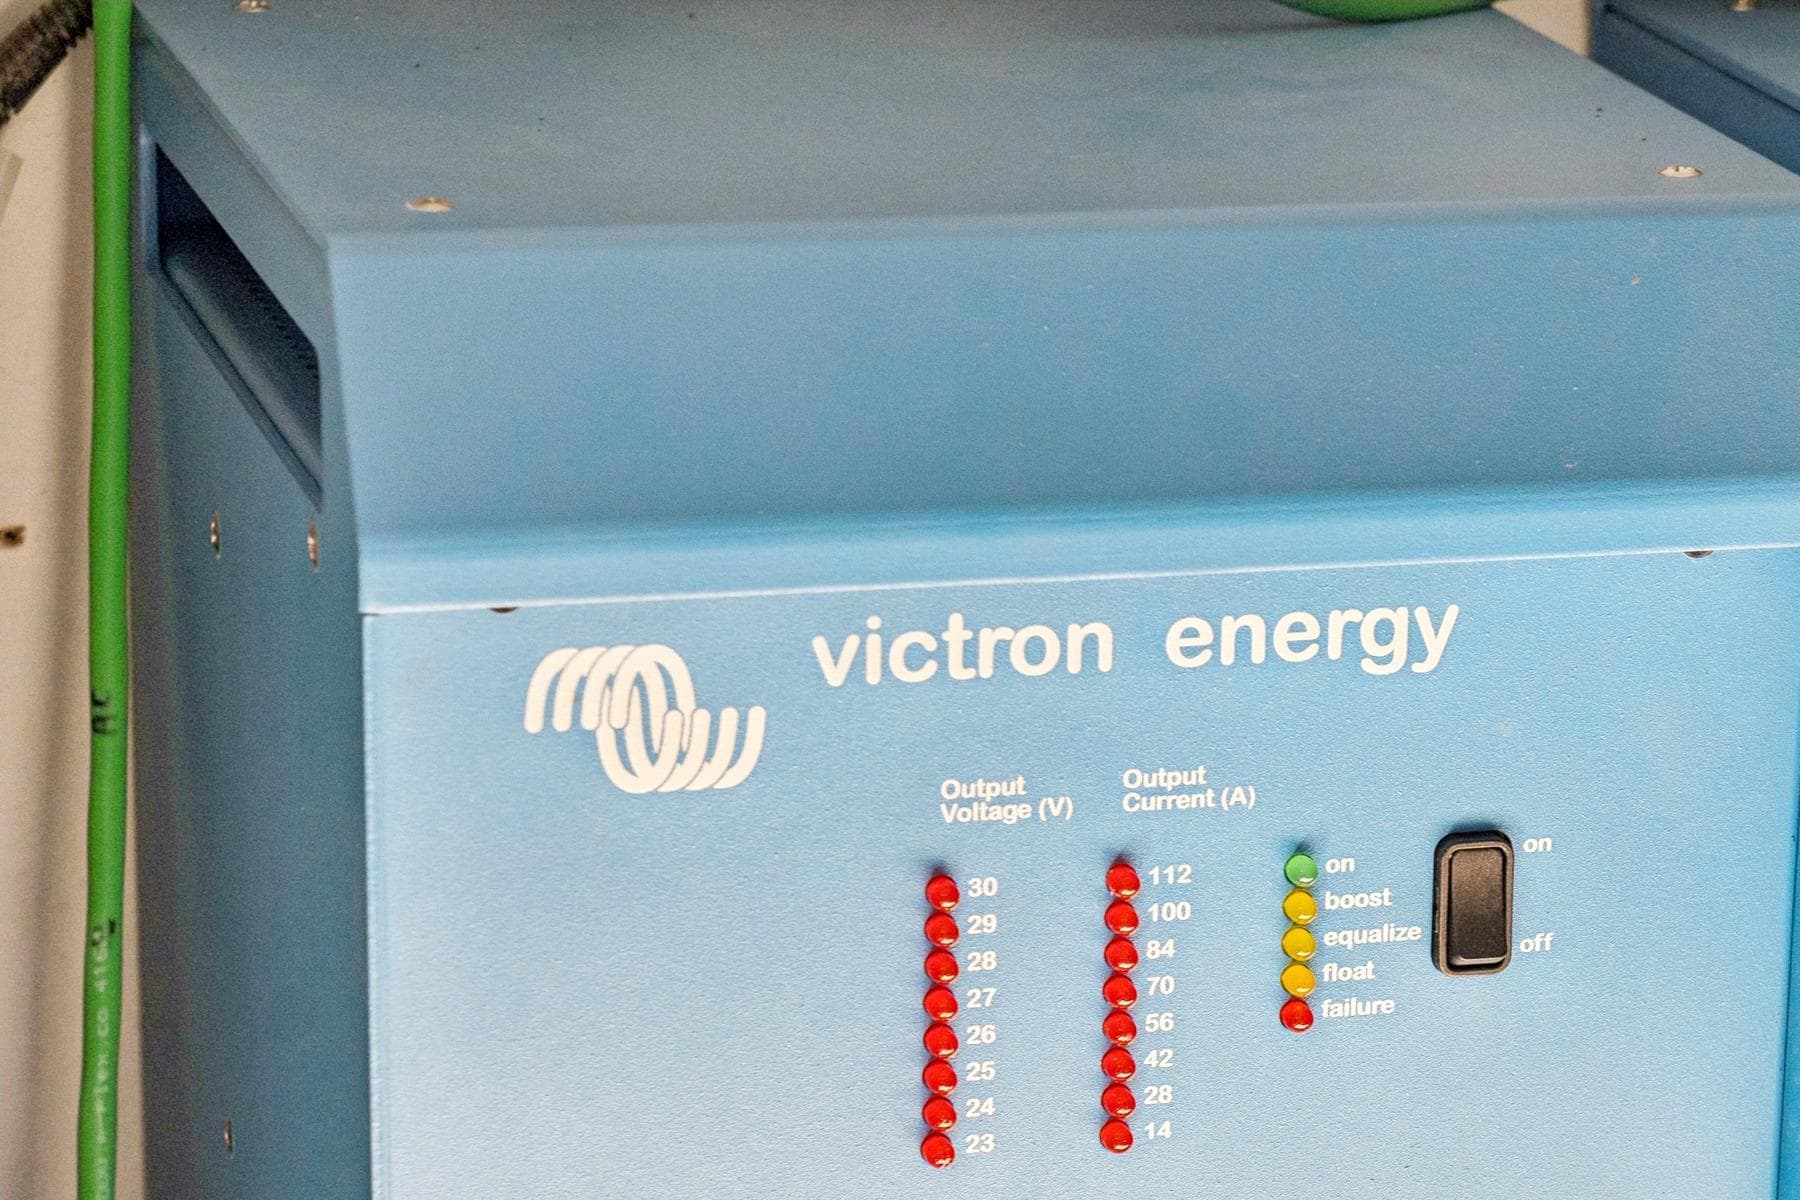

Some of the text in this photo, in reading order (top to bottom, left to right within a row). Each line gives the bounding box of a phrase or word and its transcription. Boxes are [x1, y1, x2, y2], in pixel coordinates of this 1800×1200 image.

[811, 604, 1460, 688] victron energy
[940, 775, 1027, 802] Output
[1120, 765, 1208, 790] Output
[939, 795, 1074, 825] Voltage (V)
[1122, 785, 1256, 813] Current (A)
[1522, 837, 1553, 853] on
[1147, 863, 1192, 885] 112
[1325, 857, 1356, 874] on
[967, 876, 999, 898] 30
[1324, 887, 1393, 910] boost
[1147, 901, 1192, 923] 100
[967, 913, 998, 935] 29
[1323, 922, 1422, 950] equalize
[1518, 932, 1554, 953] off
[1145, 938, 1177, 960] 84
[967, 950, 997, 972] 28
[1321, 960, 1376, 982] float
[1146, 974, 1176, 996] 70
[966, 987, 998, 1009] 27
[1320, 996, 1396, 1019] failure
[1144, 1012, 1175, 1033] 56
[965, 1024, 997, 1045] 26
[1143, 1048, 1174, 1068] 42
[965, 1060, 996, 1082] 25
[1143, 1084, 1173, 1105] 28
[965, 1096, 996, 1118] 24
[1143, 1120, 1173, 1140] 14
[965, 1133, 996, 1154] 23
